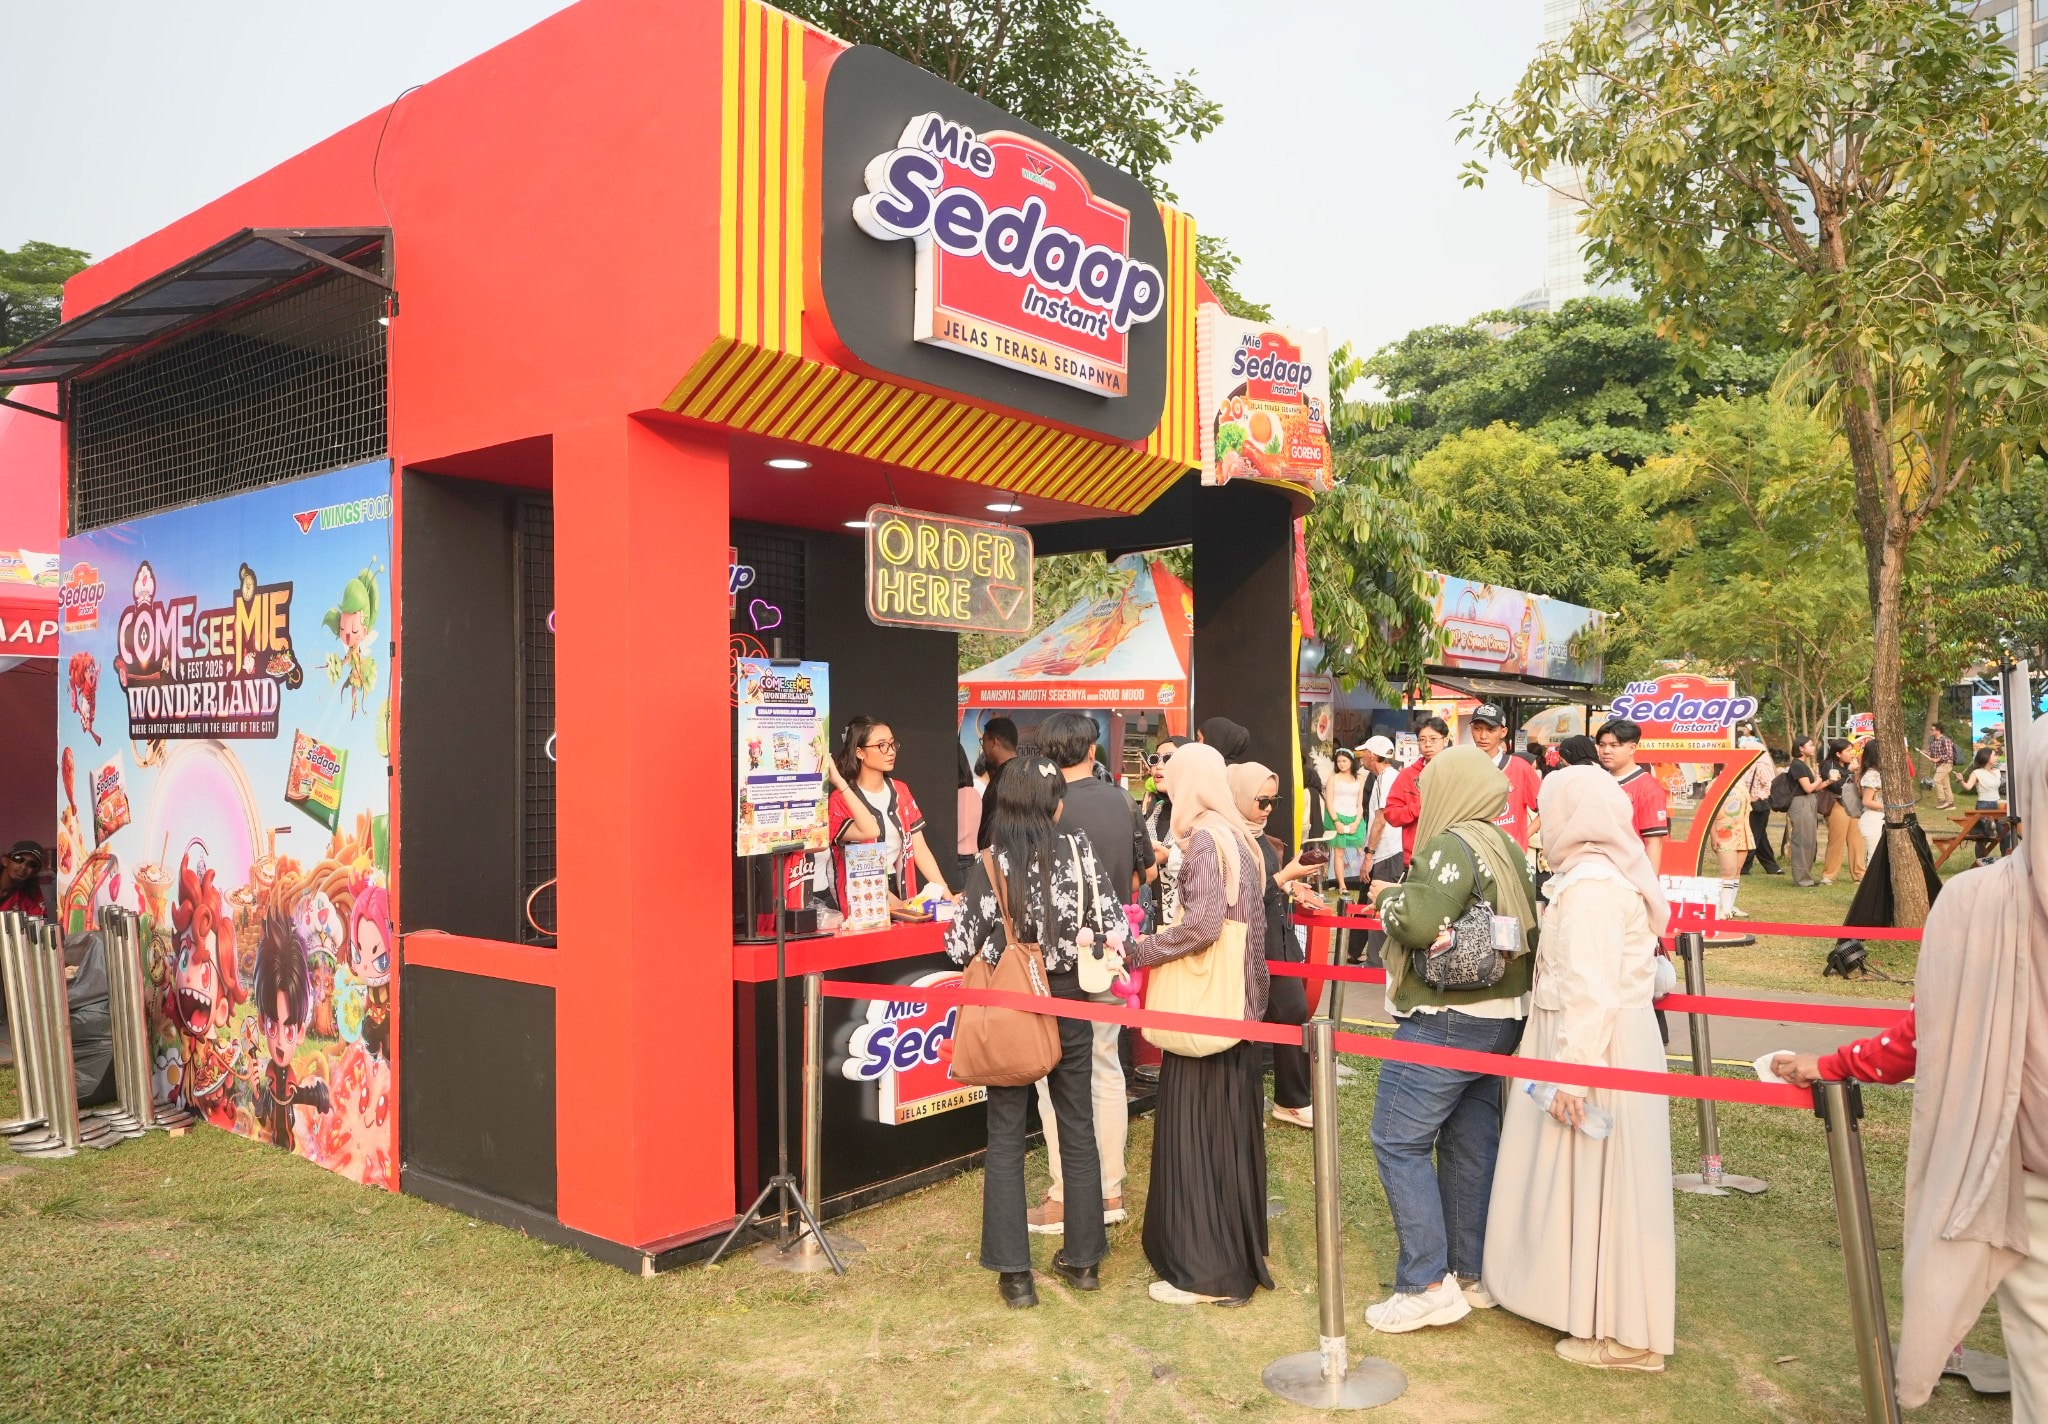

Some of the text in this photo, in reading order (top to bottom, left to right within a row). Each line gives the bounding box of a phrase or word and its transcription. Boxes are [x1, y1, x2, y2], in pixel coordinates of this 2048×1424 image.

[921, 116, 993, 174] Mie
[875, 153, 1162, 328] Sedaap
[1025, 287, 1109, 338] Instant
[1241, 334, 1261, 349] Mie
[943, 320, 1121, 391] JELAS TERASA SEDAPNYA
[1231, 349, 1312, 391] Sedaap
[1271, 383, 1297, 396] Instant
[1220, 396, 1243, 423] 20
[1308, 406, 1320, 421] 20
[1291, 445, 1321, 460] GORENG
[319, 495, 392, 530] WINGSFOOD
[878, 519, 1016, 581] ORDER
[58, 582, 105, 608] Sedaap
[878, 568, 971, 620] HERE
[119, 589, 289, 681] COME SEE MIE
[187, 659, 223, 680] FEST 2026
[760, 677, 785, 692] COME
[796, 678, 810, 692] MIE
[764, 692, 808, 700] WONDERLAND
[980, 689, 1016, 702] MANISNYA
[1016, 688, 1047, 701] SMOOTH
[1048, 688, 1087, 701] SEGERNYA
[1098, 688, 1120, 701] GOOD
[1121, 688, 1144, 701] MOOD
[1626, 682, 1657, 695] Mie
[128, 678, 279, 721] WONDERLAND
[1607, 694, 1752, 725] Sedaap
[131, 721, 275, 735] WHERE FANTASY COMES ALIVE IN THE HEART OF THE CITY
[1672, 723, 1719, 733] Instant
[1850, 719, 1873, 728] Seda
[306, 749, 341, 774] Sedaap
[96, 771, 120, 796] Sedaap
[884, 1000, 925, 1020] Mie
[860, 1009, 957, 1076] Sed
[900, 1104, 927, 1121] JELAS
[931, 1095, 965, 1111] TERASA
